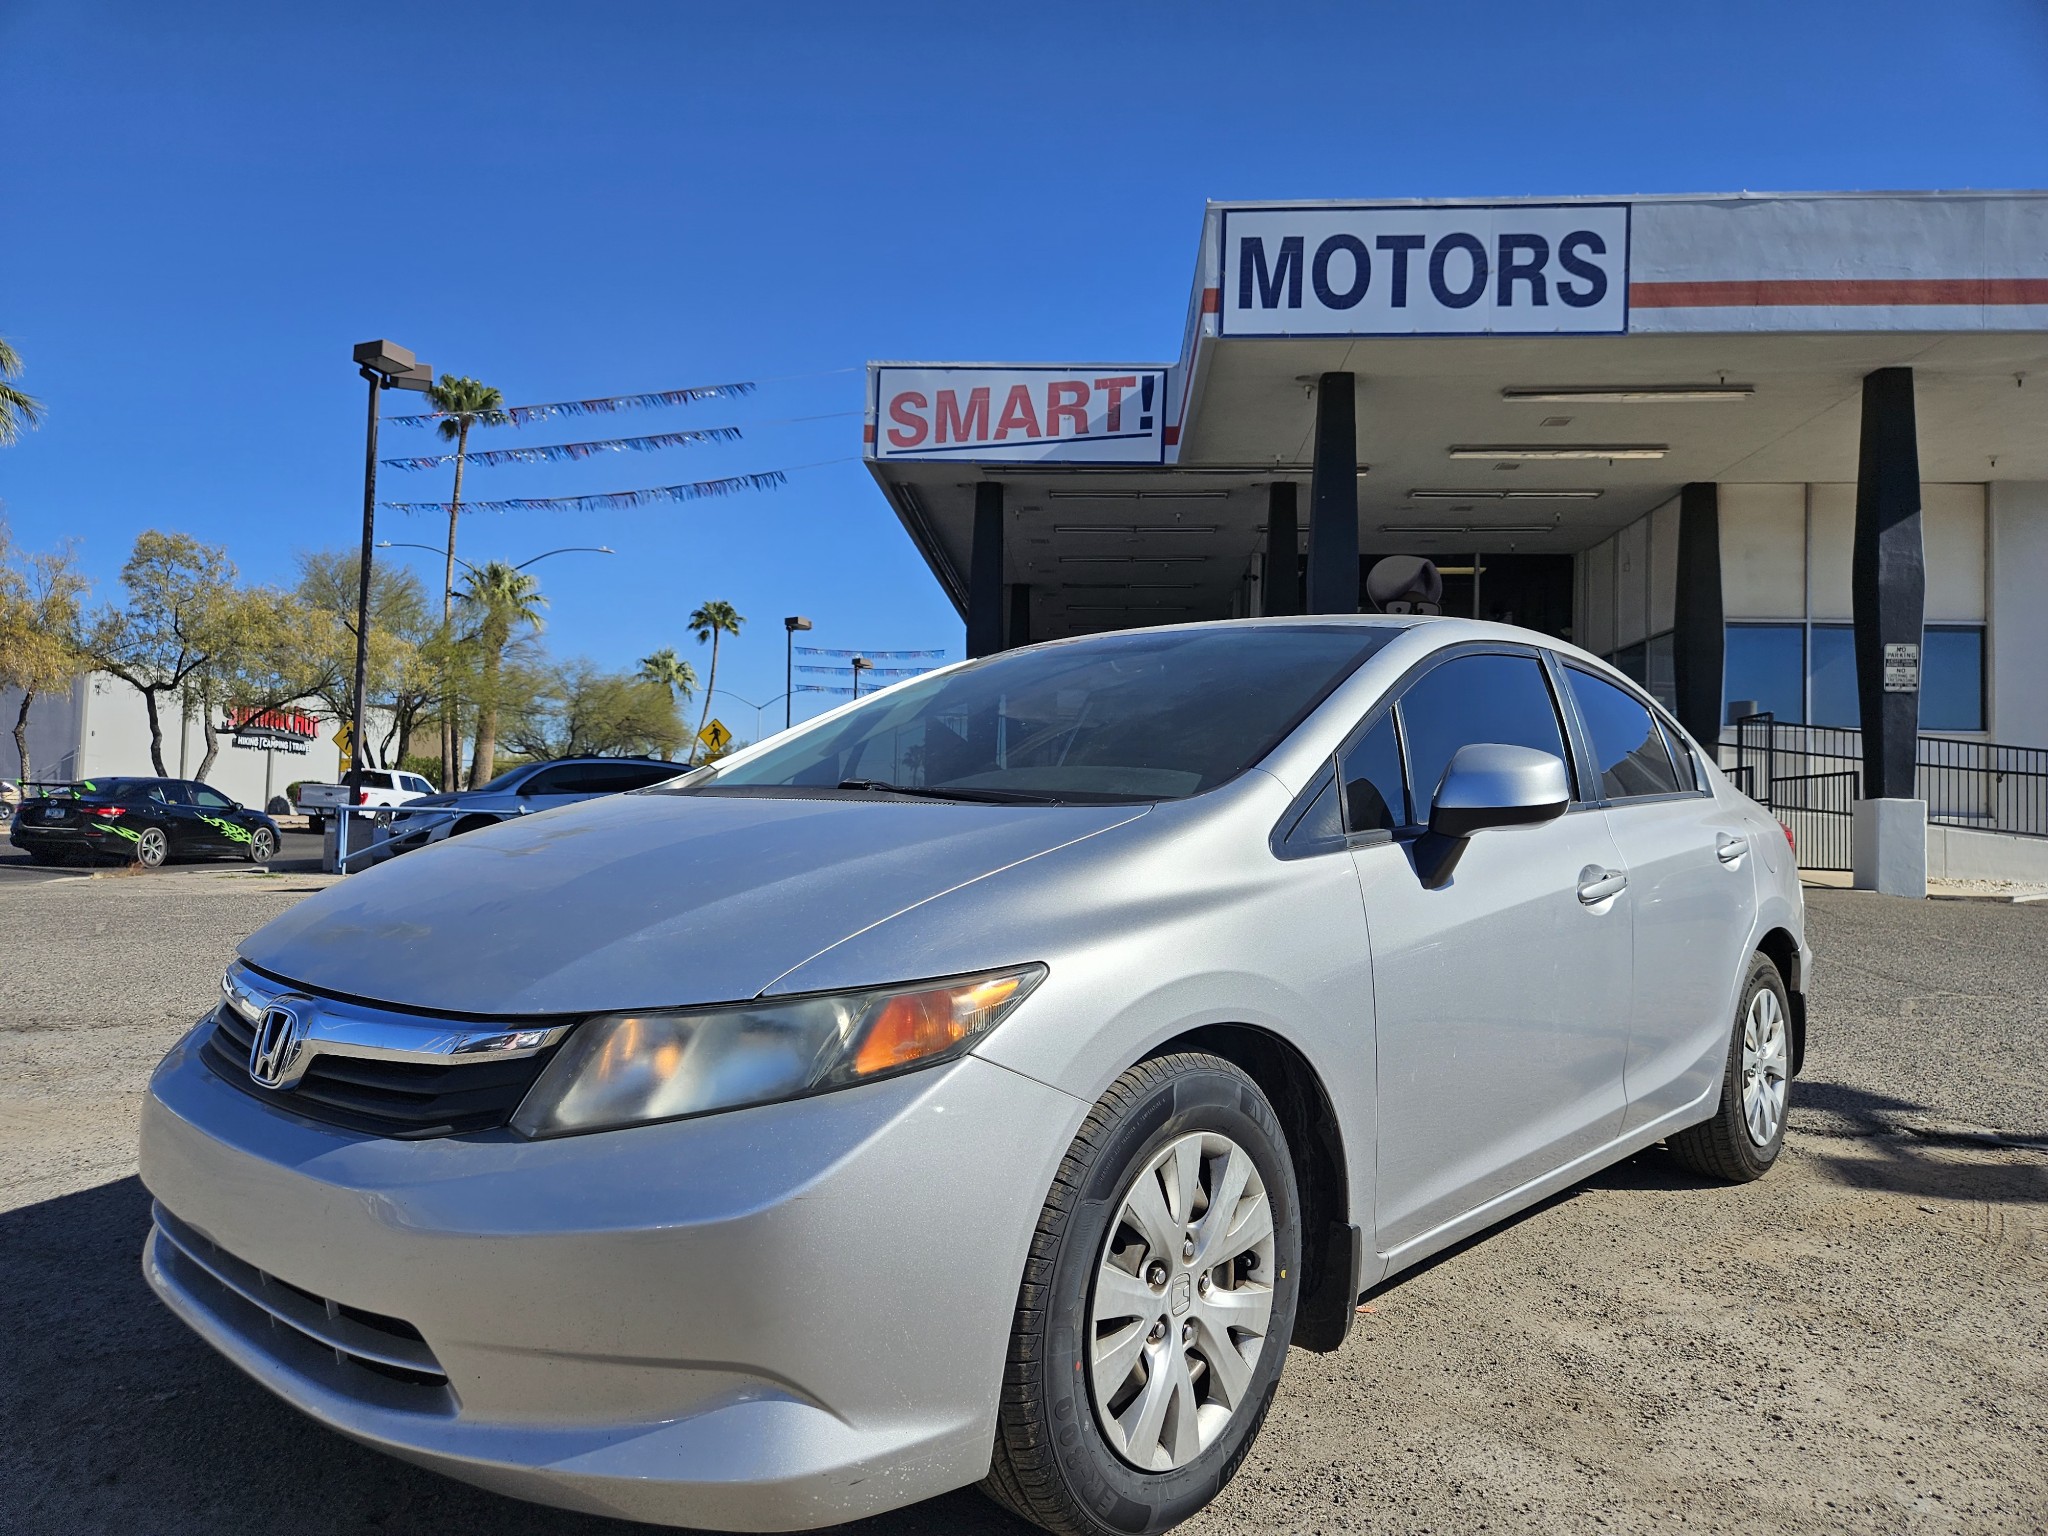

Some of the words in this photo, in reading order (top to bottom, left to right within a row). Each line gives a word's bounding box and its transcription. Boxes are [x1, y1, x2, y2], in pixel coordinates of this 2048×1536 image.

[1238, 230, 1608, 310] MOTORS
[886, 375, 1155, 448] SMART!
[237, 736, 259, 747] HIKING
[262, 737, 289, 750] CAMPING
[1054, 1396, 1119, 1518] ER-800
